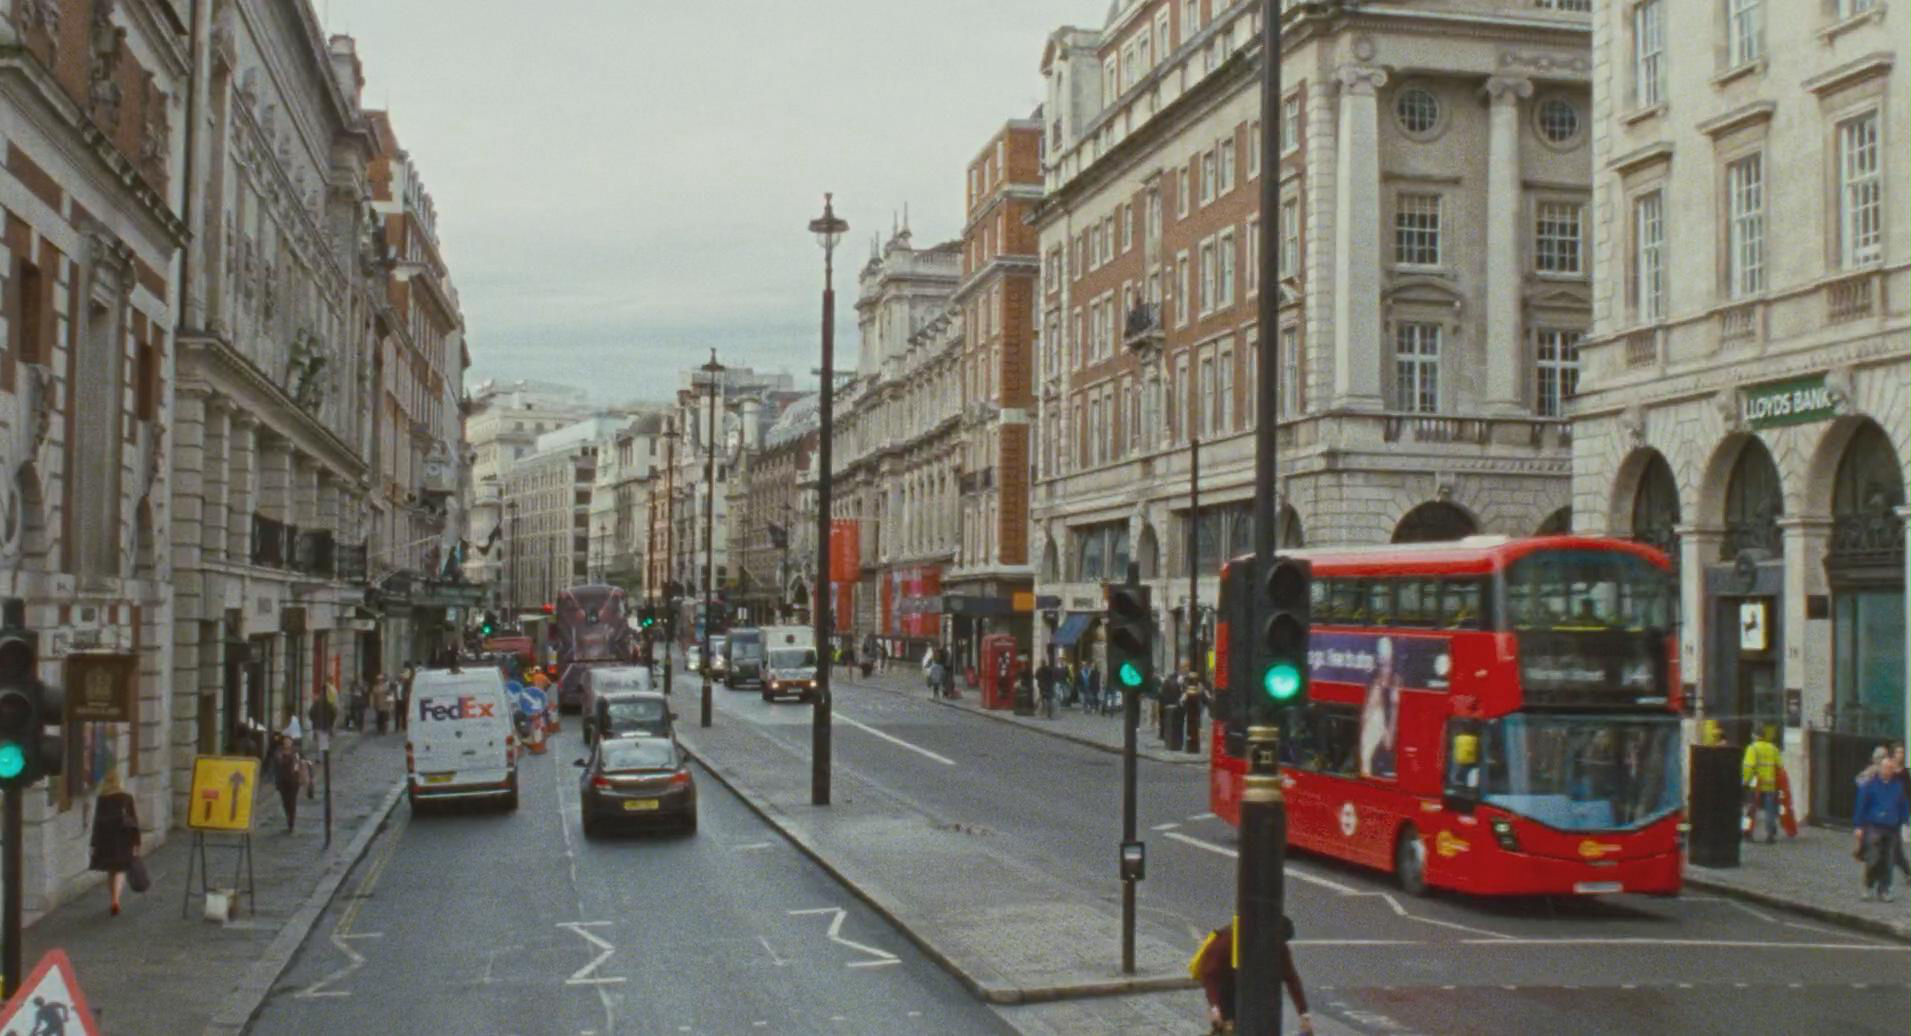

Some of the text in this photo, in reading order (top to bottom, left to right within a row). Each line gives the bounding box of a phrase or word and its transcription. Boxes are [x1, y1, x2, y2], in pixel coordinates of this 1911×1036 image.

[1743, 387, 1833, 420] LLOYDS BANK
[419, 696, 495, 721] FedEx
